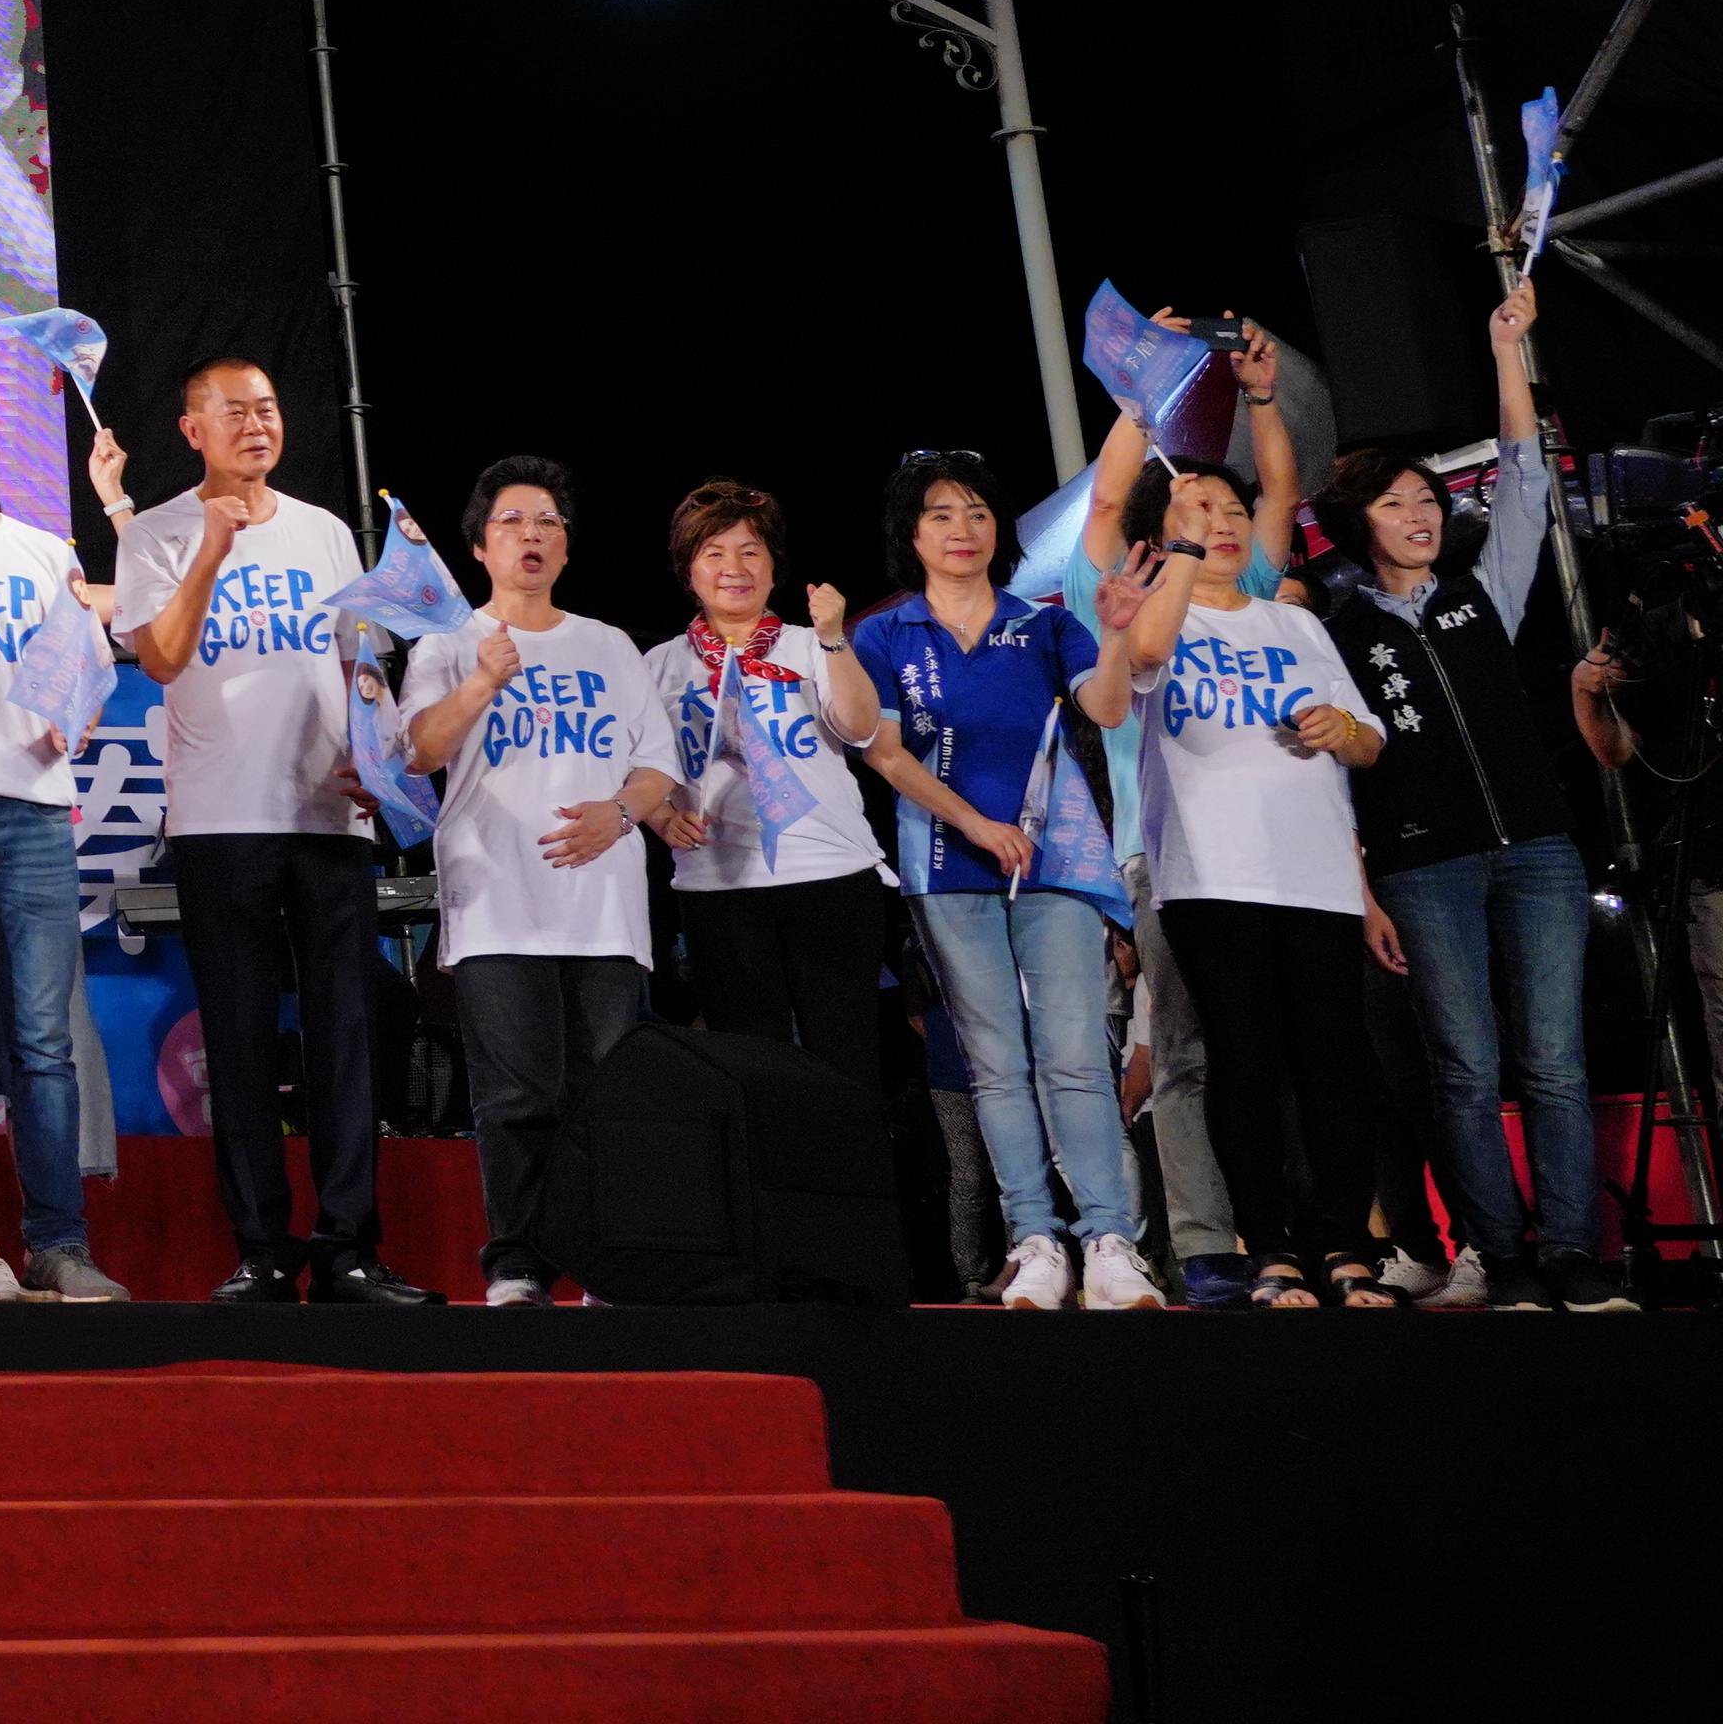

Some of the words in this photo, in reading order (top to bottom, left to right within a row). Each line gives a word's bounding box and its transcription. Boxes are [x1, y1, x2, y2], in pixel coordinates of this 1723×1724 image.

[211, 564, 315, 613] KEEP
[988, 632, 1031, 649] KMT
[1437, 601, 1480, 631] KMT
[1172, 633, 1299, 685] KEEP
[901, 662, 939, 737] 李貴敏
